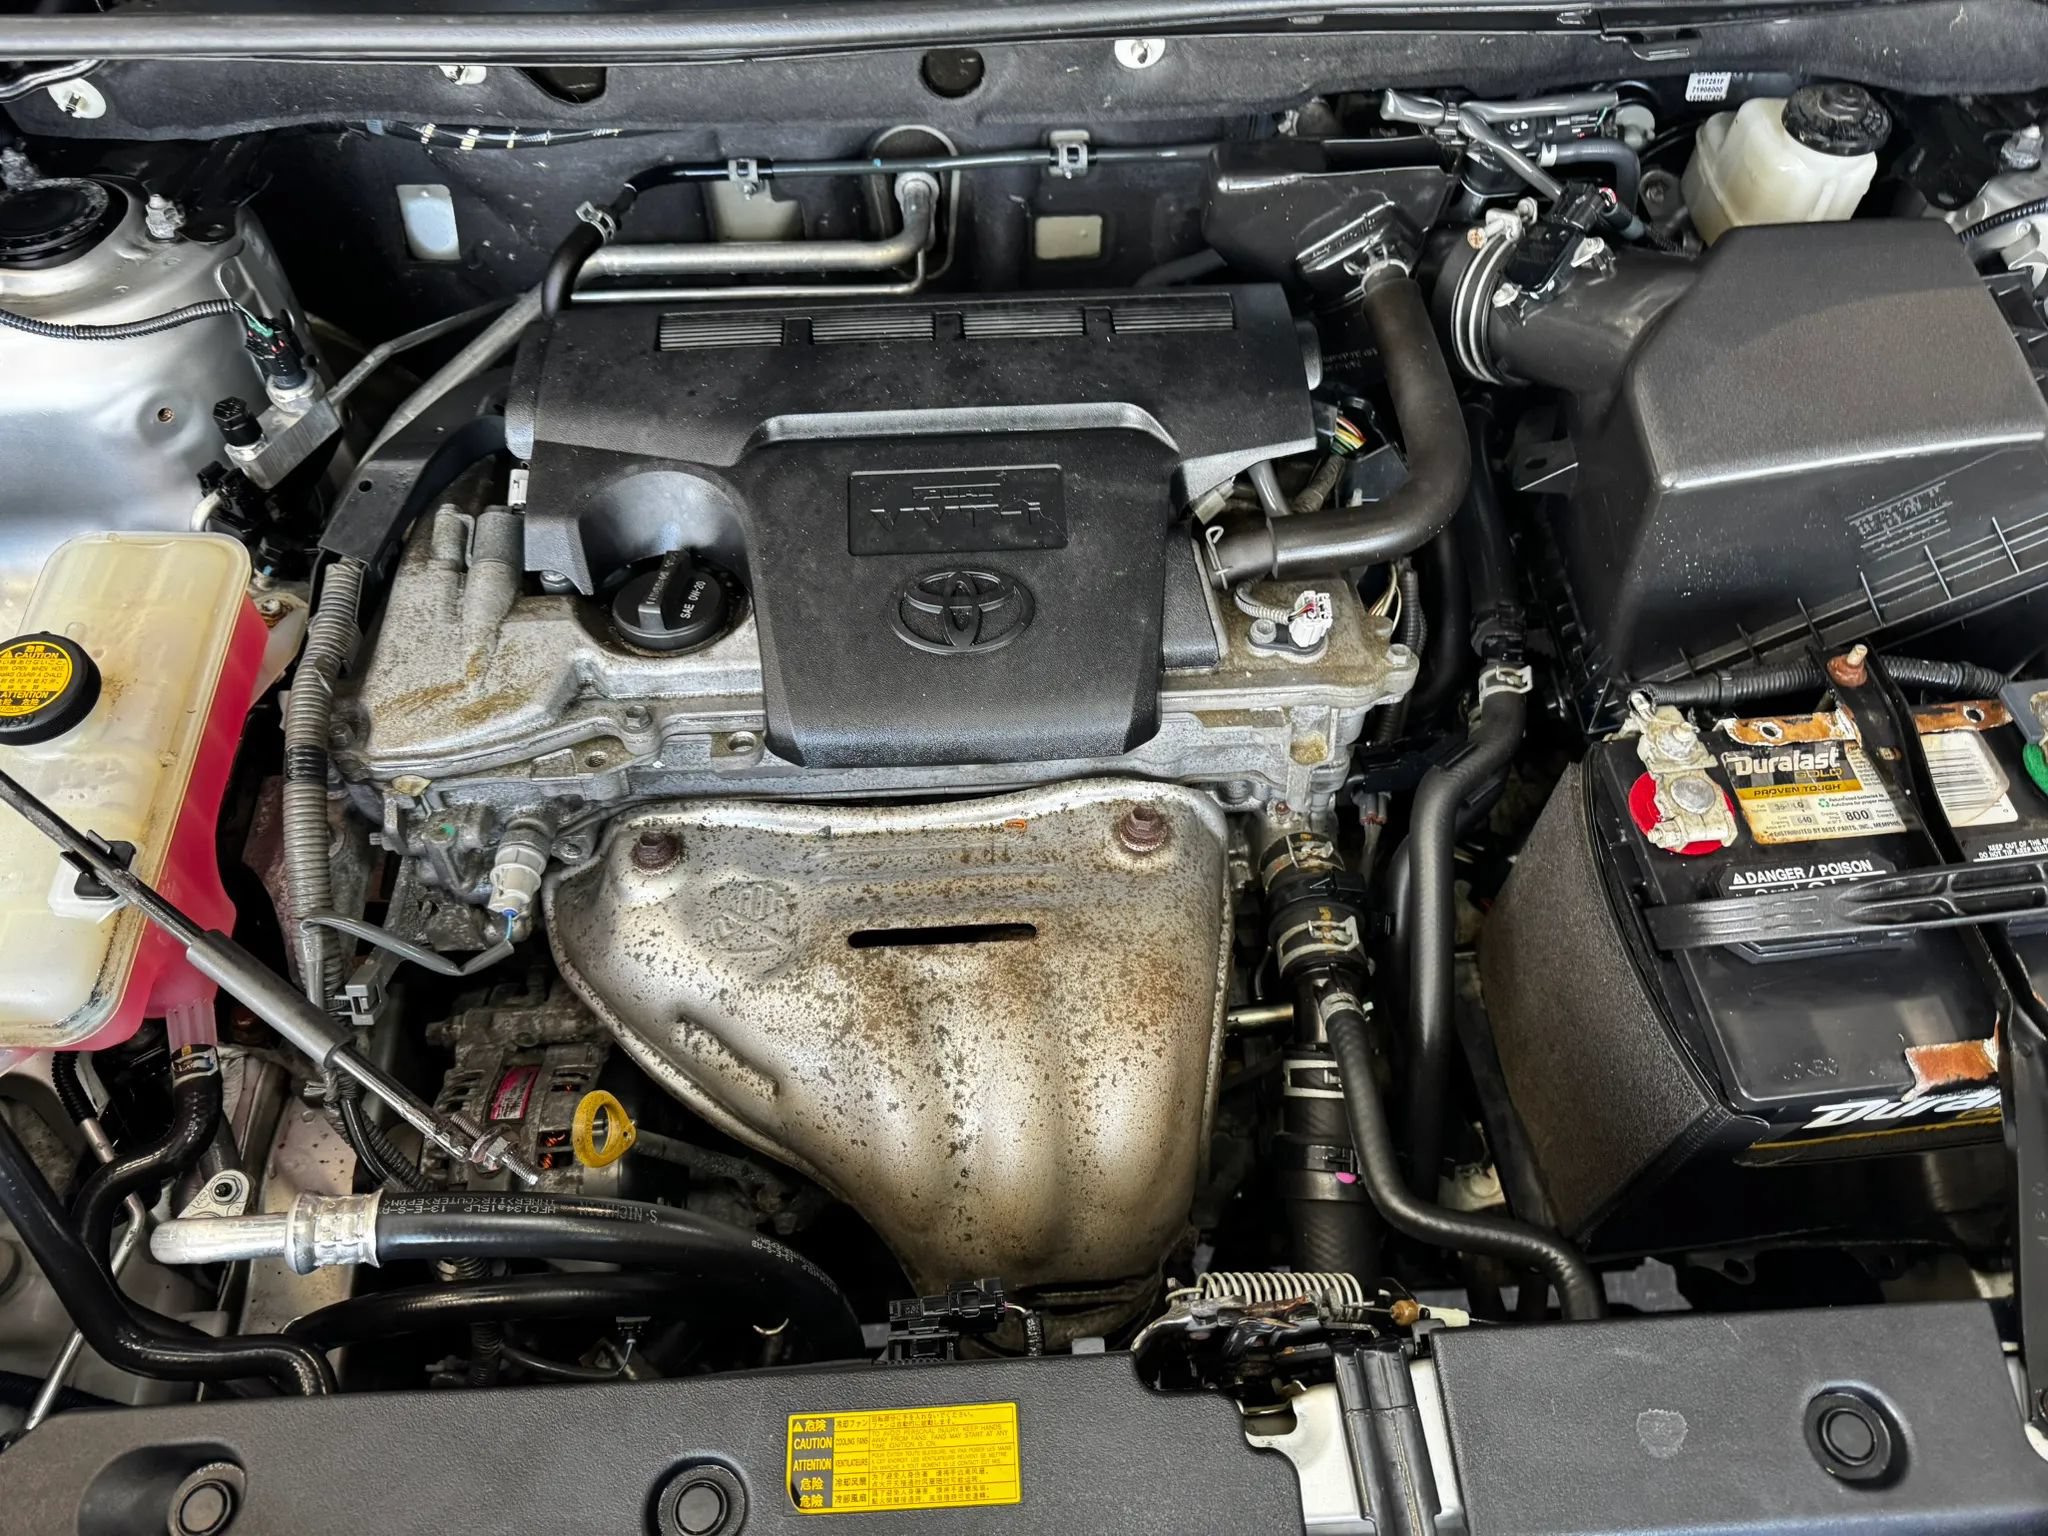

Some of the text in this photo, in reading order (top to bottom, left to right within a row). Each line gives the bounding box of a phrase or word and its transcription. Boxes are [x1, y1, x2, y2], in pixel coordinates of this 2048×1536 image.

[680, 603, 695, 619] SAE
[1721, 746, 1841, 776] Duralast
[1754, 784, 1841, 797] PROVEN TOUGH
[1845, 810, 1869, 821] 800
[1989, 850, 2002, 858] NOT
[1745, 859, 1873, 884] DANGER / POISON
[794, 1436, 832, 1450] CAUTION
[835, 1436, 868, 1446] COOLING FANS
[792, 1458, 832, 1471] ATTENTION
